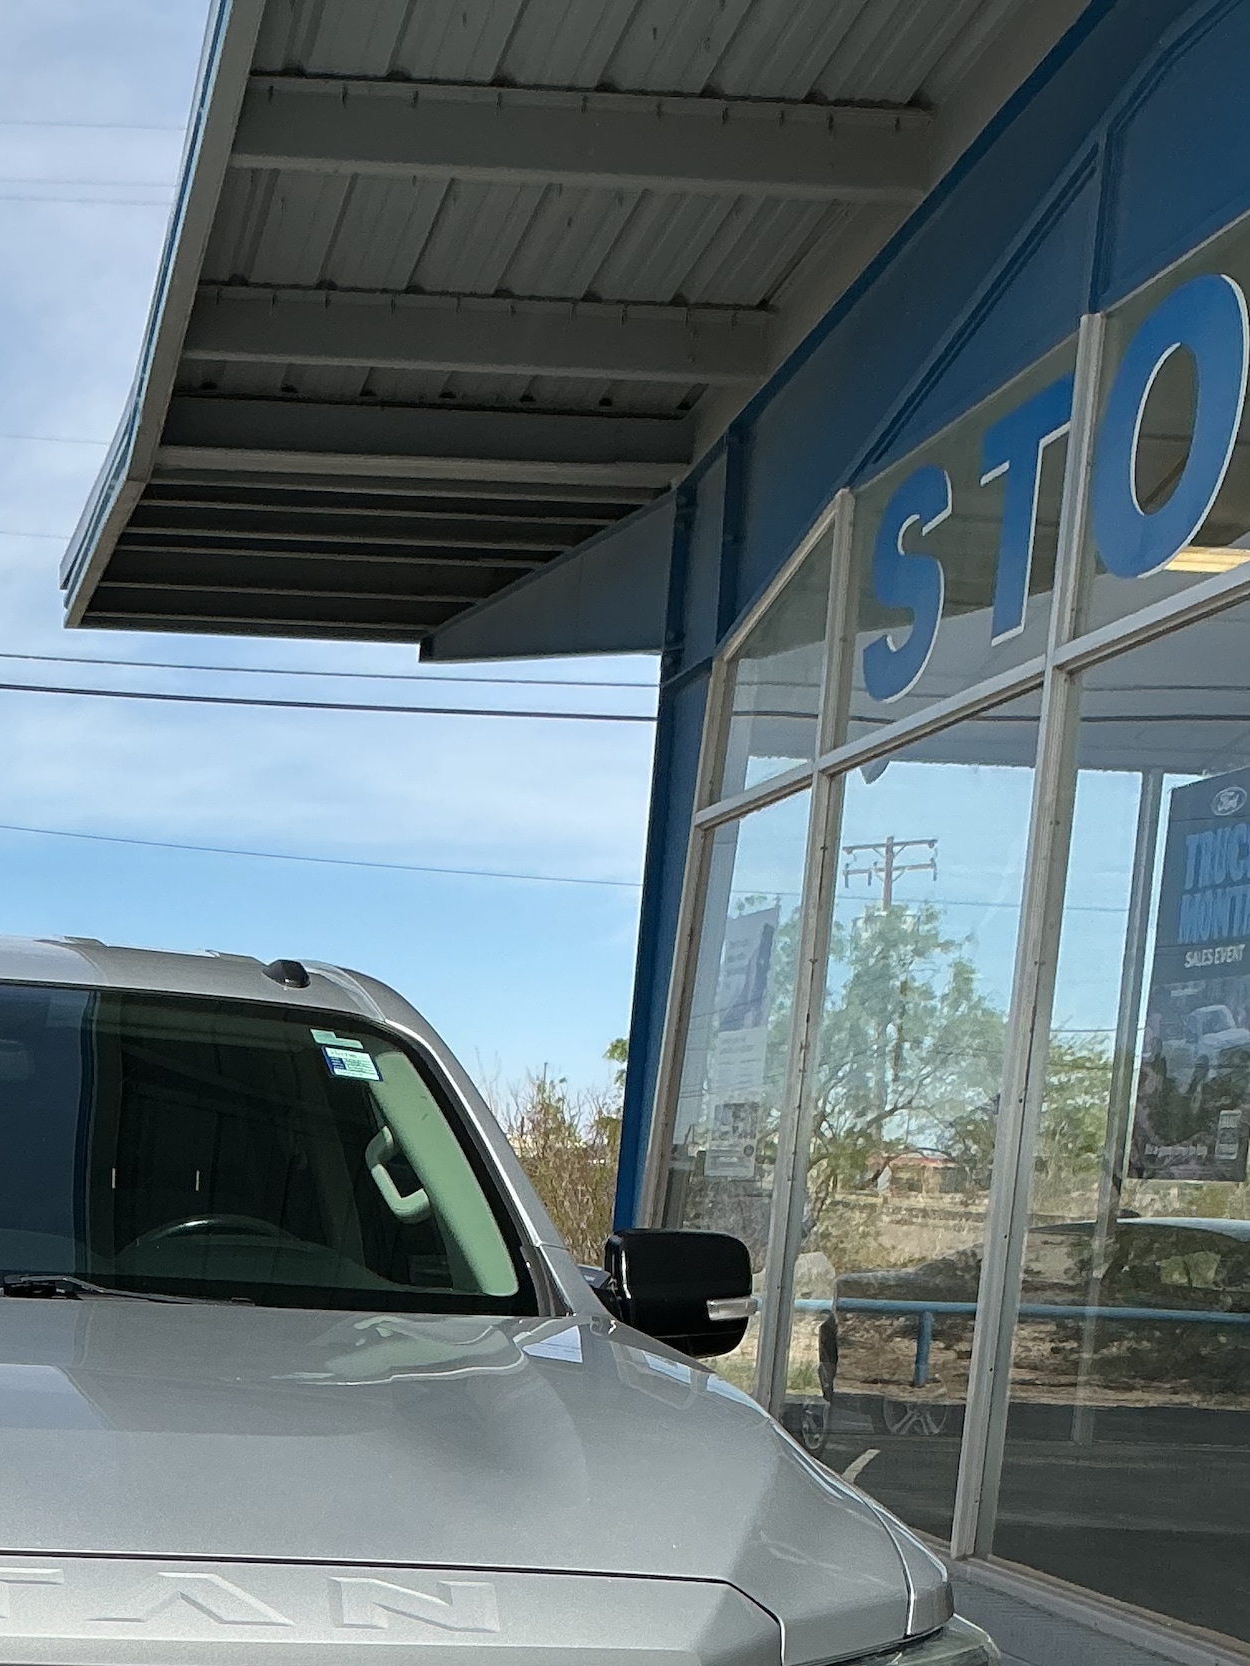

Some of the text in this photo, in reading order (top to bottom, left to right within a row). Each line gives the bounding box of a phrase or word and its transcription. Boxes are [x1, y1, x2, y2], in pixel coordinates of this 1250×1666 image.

[1184, 823, 1250, 890] TRUC
[1184, 944, 1245, 968] SALES EVENT
